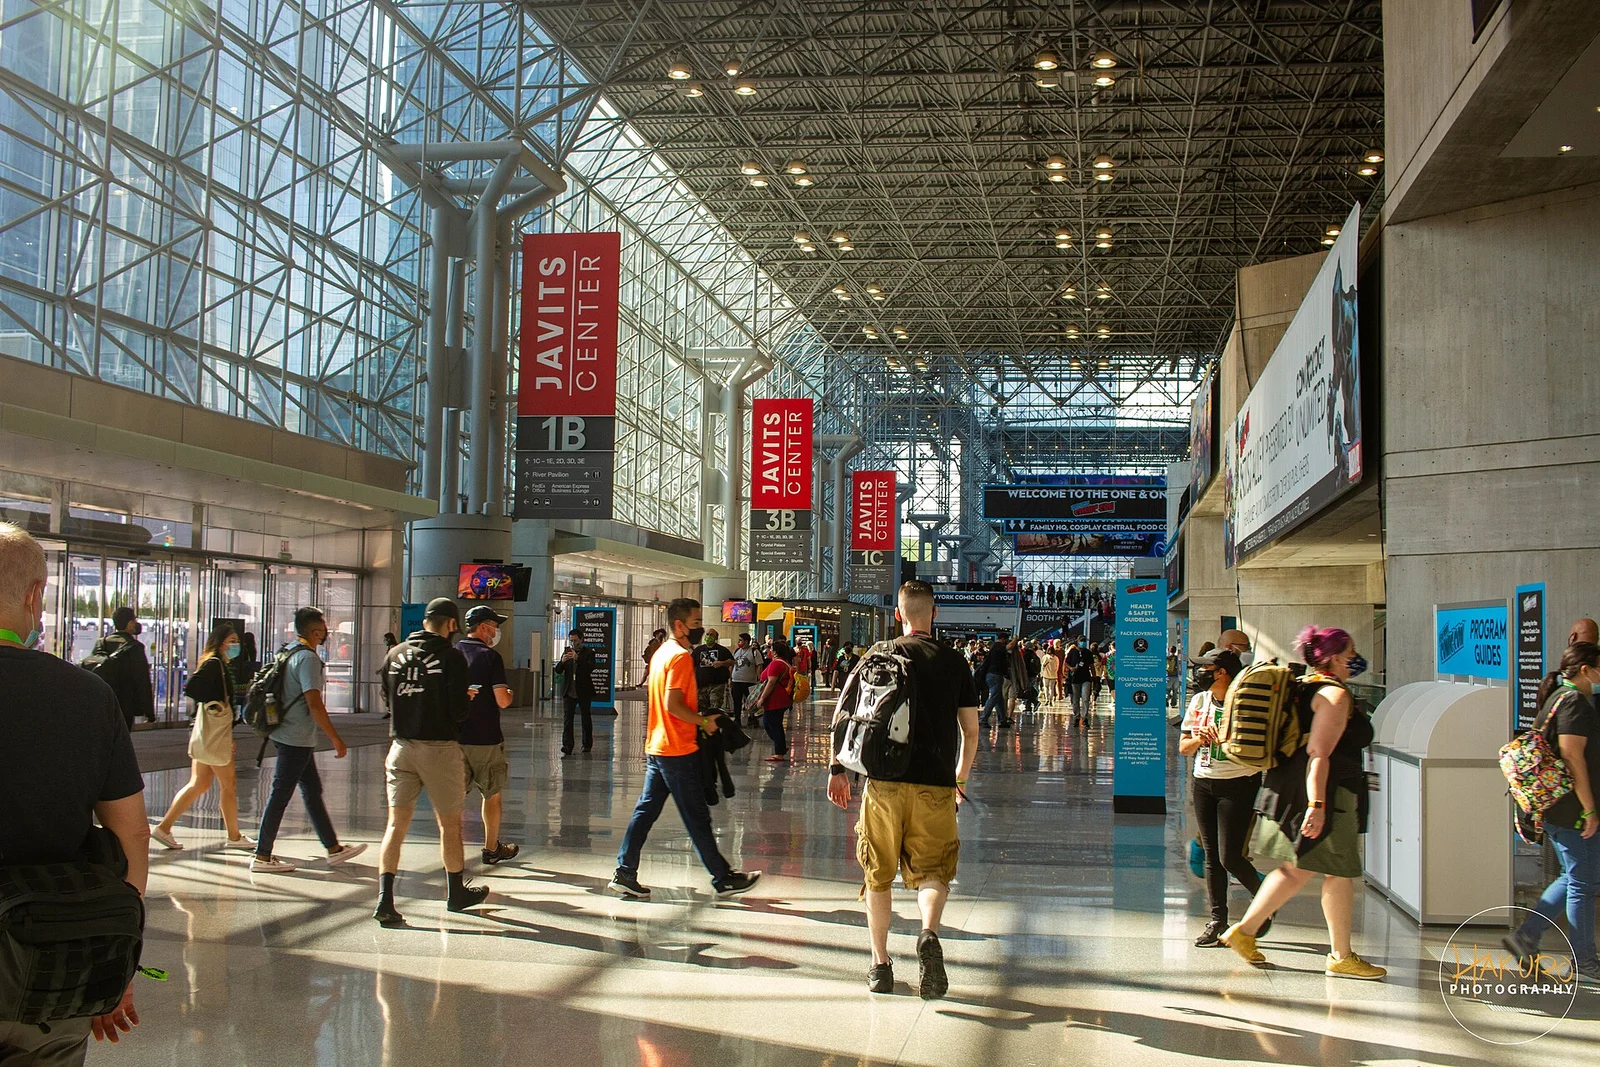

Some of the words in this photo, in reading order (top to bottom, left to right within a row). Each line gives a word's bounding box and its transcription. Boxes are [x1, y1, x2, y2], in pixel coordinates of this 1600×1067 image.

[536, 257, 566, 390] JAVITS
[576, 256, 601, 391] CENTER
[542, 416, 586, 450] 1B
[762, 413, 780, 494] JAVITS
[787, 412, 802, 494] CENTER
[859, 481, 873, 539] JAVITS
[877, 481, 888, 540] CENTER
[1007, 489, 1066, 498] WELCOME
[1069, 489, 1084, 498] TO
[1087, 490, 1108, 498] THE
[1111, 490, 1136, 499] ONE
[1139, 490, 1147, 499] &
[765, 510, 796, 530] 3B
[862, 550, 884, 566] 1C
[1470, 618, 1507, 640] PROGRAM
[1474, 644, 1502, 666] GUIDES
